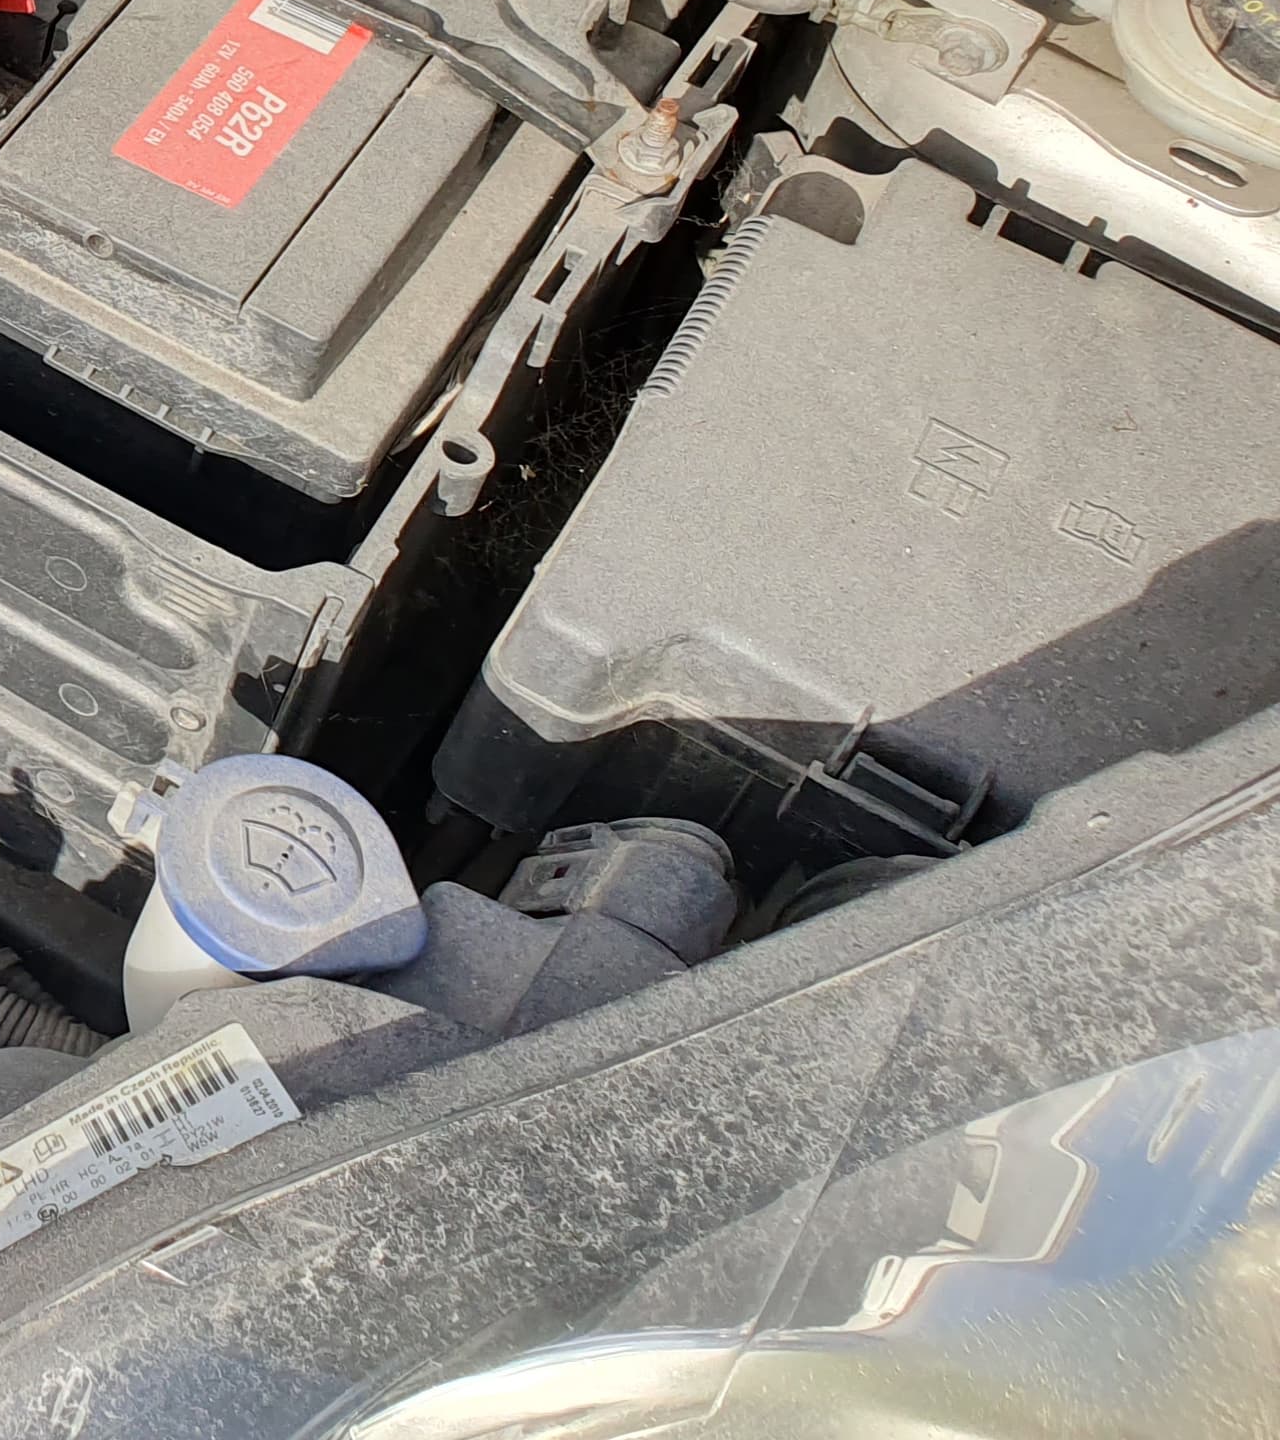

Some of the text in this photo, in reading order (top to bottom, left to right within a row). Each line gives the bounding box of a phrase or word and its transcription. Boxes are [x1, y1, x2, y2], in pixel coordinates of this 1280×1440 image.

[217, 39, 241, 60] 12V
[191, 62, 220, 89] 60Ah
[162, 93, 194, 123] 540A
[186, 66, 255, 141] 560 408 054
[214, 85, 288, 157] P62R
[143, 127, 167, 146] EN
[68, 1100, 104, 1126] Made
[104, 1092, 119, 1105] in
[118, 1069, 161, 1097] Czech
[10, 1166, 52, 1197] LHD
[61, 1190, 78, 1205] 00
[89, 1174, 107, 1189] 00
[114, 1160, 132, 1176] 02
[77, 1163, 98, 1180] HC
